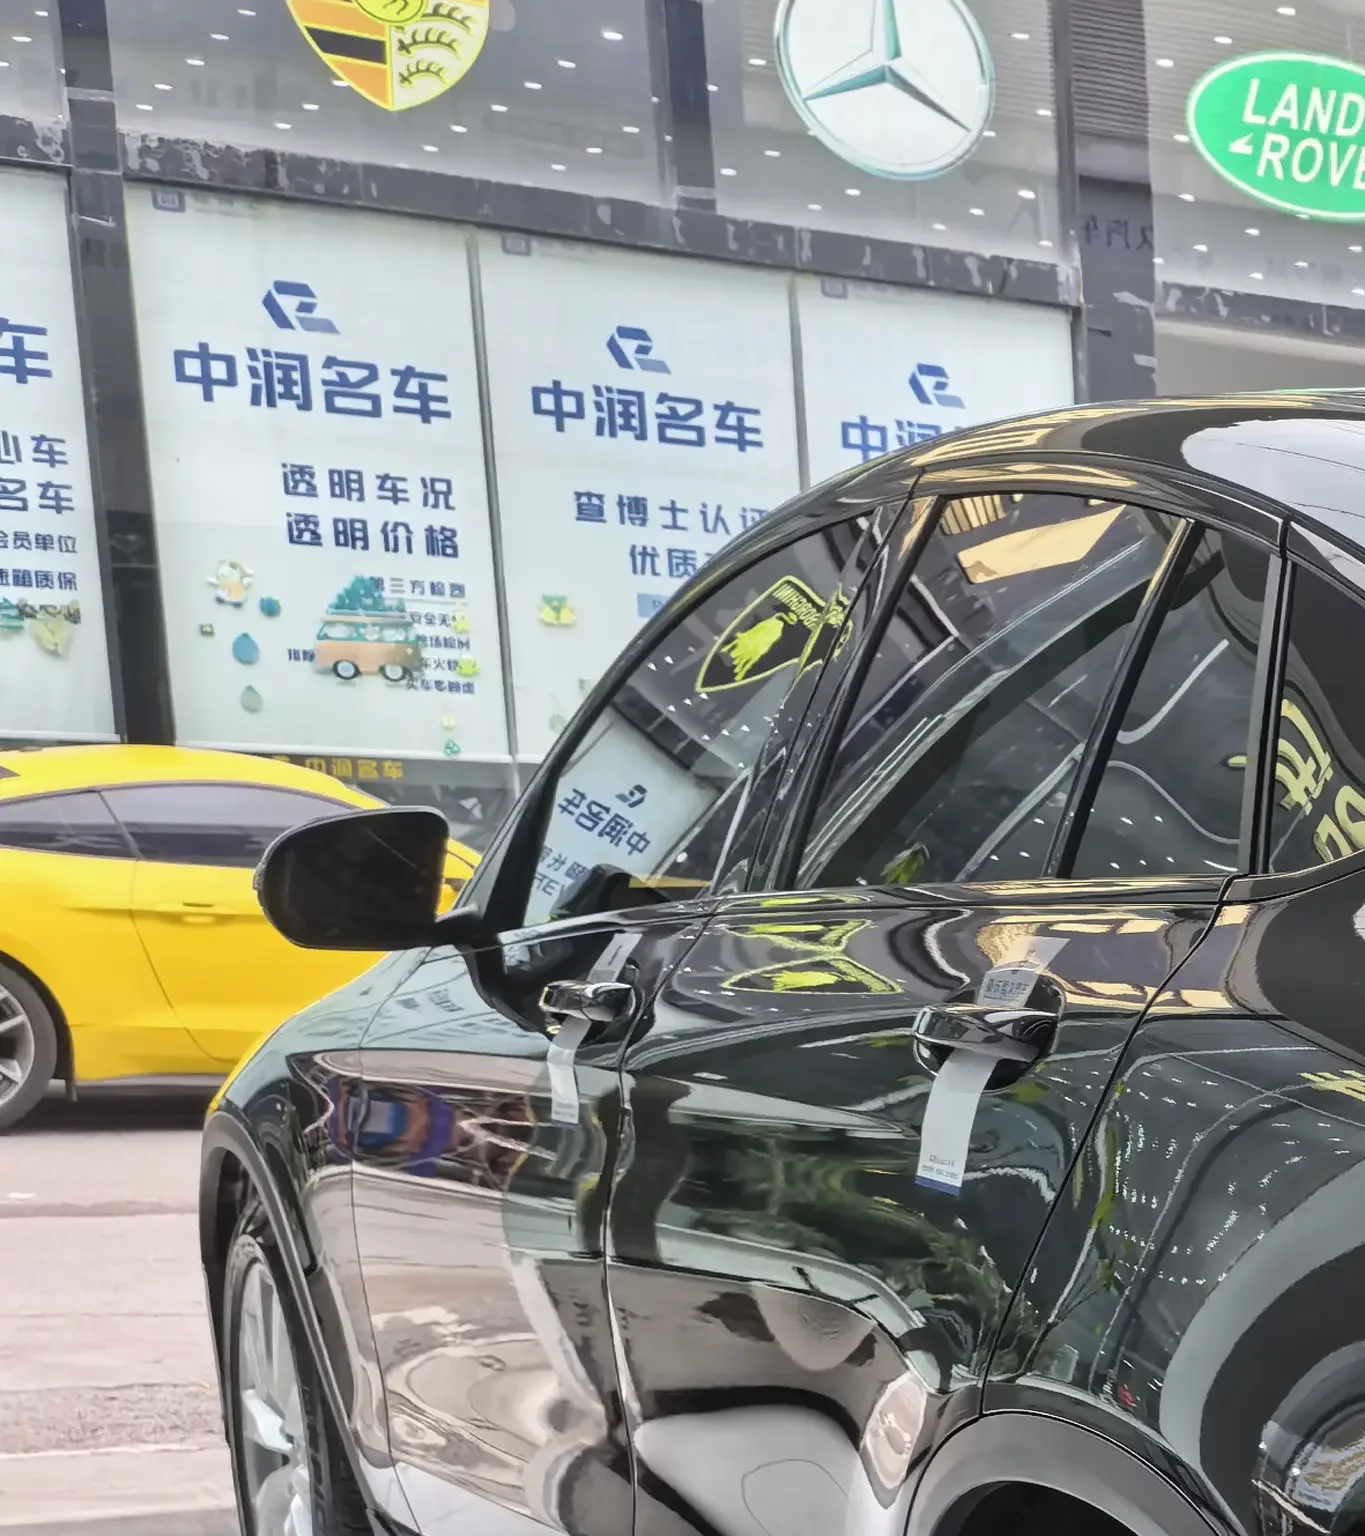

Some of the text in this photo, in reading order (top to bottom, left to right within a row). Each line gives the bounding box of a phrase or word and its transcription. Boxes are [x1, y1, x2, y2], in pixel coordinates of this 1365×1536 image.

[1241, 77, 1365, 138] LAND
[173, 341, 452, 424] 中润名车
[530, 378, 764, 453] 中润名车
[281, 462, 456, 511] 透明车况
[286, 512, 459, 559] 透明价格
